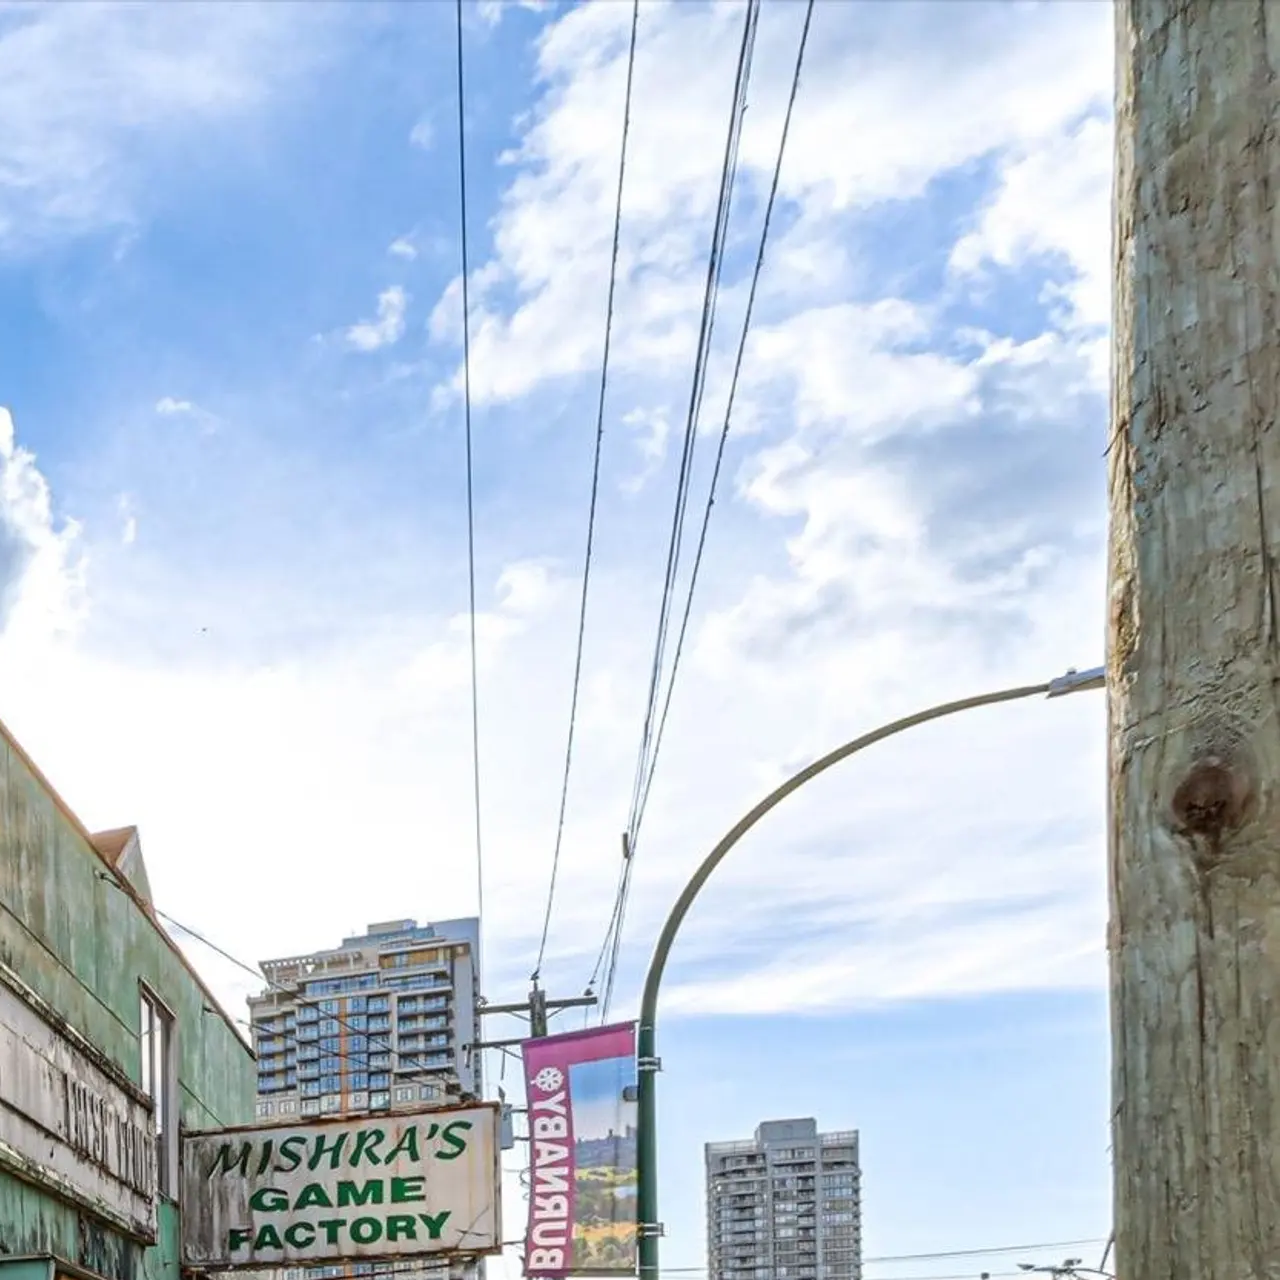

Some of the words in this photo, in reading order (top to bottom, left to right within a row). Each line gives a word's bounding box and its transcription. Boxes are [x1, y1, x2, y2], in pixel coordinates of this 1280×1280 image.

[208, 1121, 473, 1177] MISHRA'S
[249, 1176, 427, 1212] GAME
[228, 1211, 453, 1251] FACTORY
